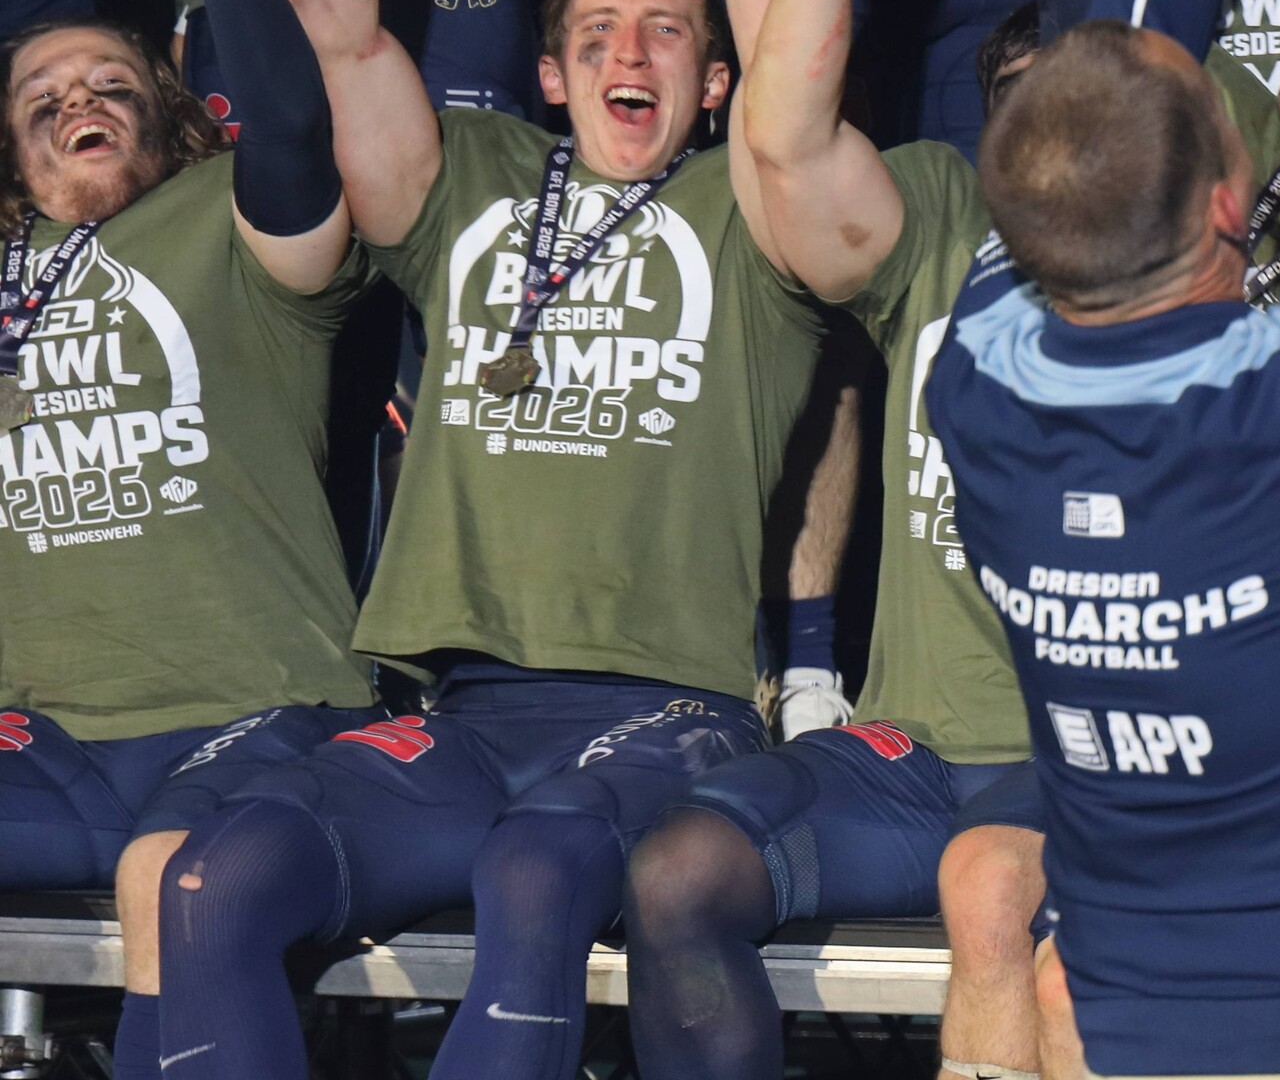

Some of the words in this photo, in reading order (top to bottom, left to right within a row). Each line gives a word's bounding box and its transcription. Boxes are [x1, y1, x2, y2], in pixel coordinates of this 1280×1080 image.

[549, 170, 564, 192] GFL
[541, 192, 561, 226] BOWL
[591, 210, 624, 240] BOWL
[618, 181, 652, 210] 2026
[42, 261, 64, 283] GFL
[57, 227, 90, 260] BOWL
[535, 227, 553, 260] 2026
[6, 251, 22, 282] 2026
[474, 384, 633, 440] 2026
[513, 438, 608, 458] BUNDESWEHR
[3, 465, 152, 533] 2026
[52, 523, 144, 548] BUNDESWEHR
[1034, 636, 1181, 672] FOOTBALL
[1105, 710, 1213, 777] APP
